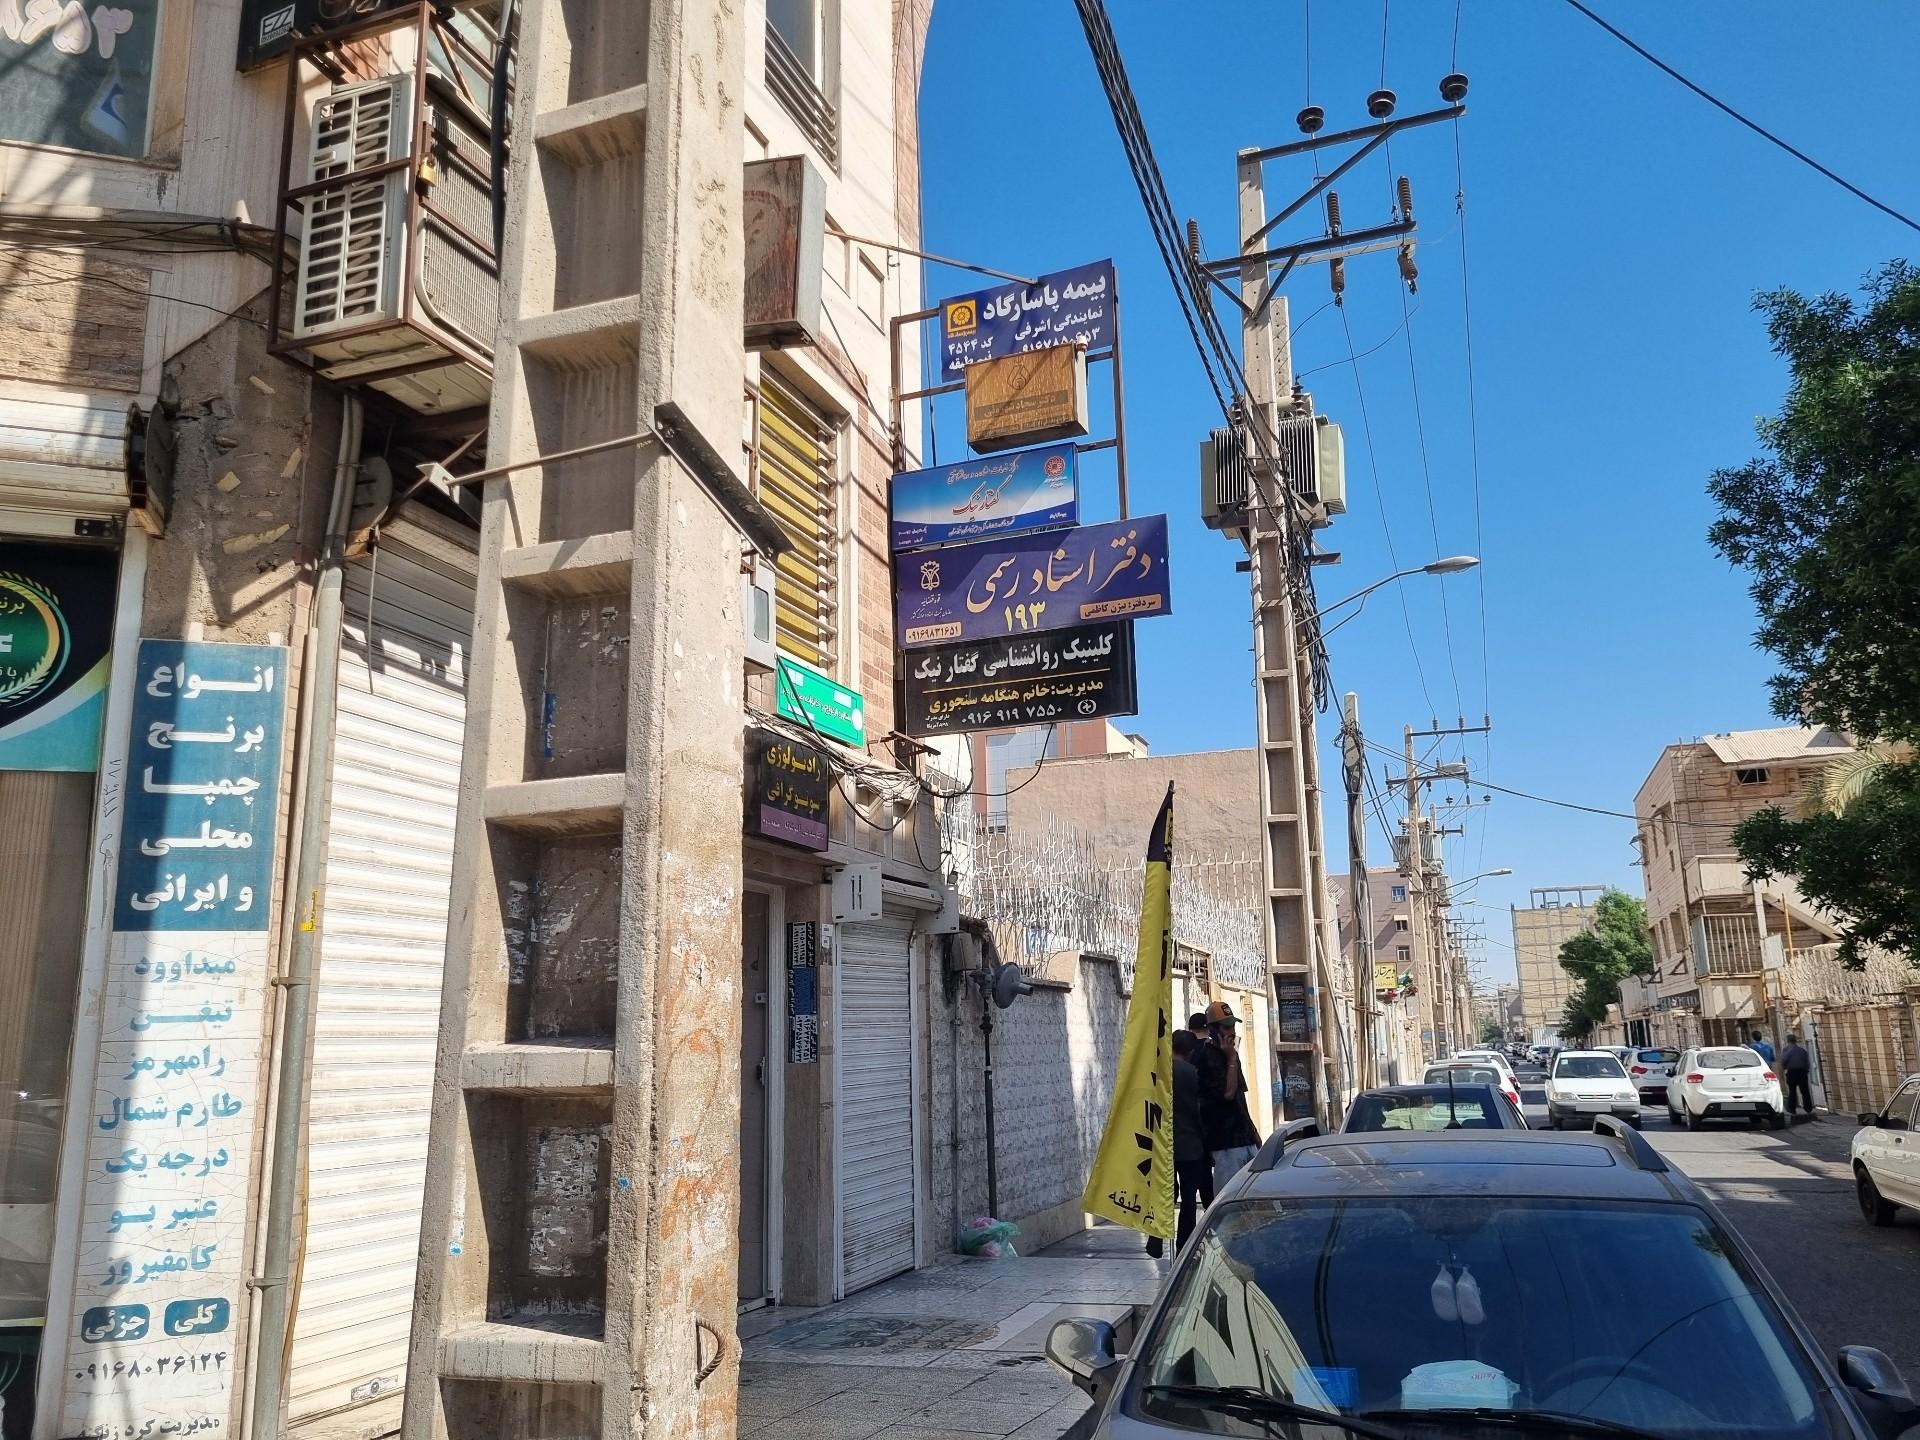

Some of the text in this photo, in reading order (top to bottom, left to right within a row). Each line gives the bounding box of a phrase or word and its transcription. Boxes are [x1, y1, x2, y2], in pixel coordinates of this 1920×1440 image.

[983, 275, 1106, 322] بیمه پاسارگاد
[1014, 305, 1103, 341] نمایندگی اشرفی
[948, 336, 994, 356] کد ۴۵۴۴
[949, 355, 974, 371] طبقه
[966, 530, 1152, 614] دفتر اسناد رسمی
[1003, 600, 1046, 632] ۱۹۳
[1085, 604, 1109, 617] کاظمی
[908, 626, 958, 640] ۰۹۱۶۹۸۳۱۶۵۱
[914, 632, 1114, 683] کلینیک روانشناسی گفتار نیک
[146, 662, 274, 699] انواع
[980, 689, 1020, 703] هنگامه
[929, 693, 978, 714] سنجوری
[961, 707, 992, 725] ۰۹۱۶
[997, 707, 1020, 723] ۹۱۹
[1026, 703, 1063, 718] ۷۵۵۰
[148, 716, 265, 752] برنج
[767, 743, 821, 782] رادیولوژی
[143, 766, 261, 806] چمپا
[767, 777, 820, 815] سونوگرافی
[141, 820, 252, 857] محلی
[130, 873, 253, 912] و ایرانی
[134, 951, 236, 983] میداوود
[1374, 966, 1396, 979] دبیرستان
[123, 1045, 226, 1080] رامهرمز
[99, 1092, 243, 1131] طارم شمال
[105, 1147, 229, 1179] درجه یک
[106, 1198, 219, 1234] عنبر بو
[1107, 1190, 1143, 1214] طبقه
[100, 1244, 217, 1286] کامفیروز
[174, 1303, 218, 1333] کلی
[75, 1351, 227, 1382] ۰۹۱۶۸۰۳۶۱۲۴
[160, 1416, 220, 1436] مدیریت
